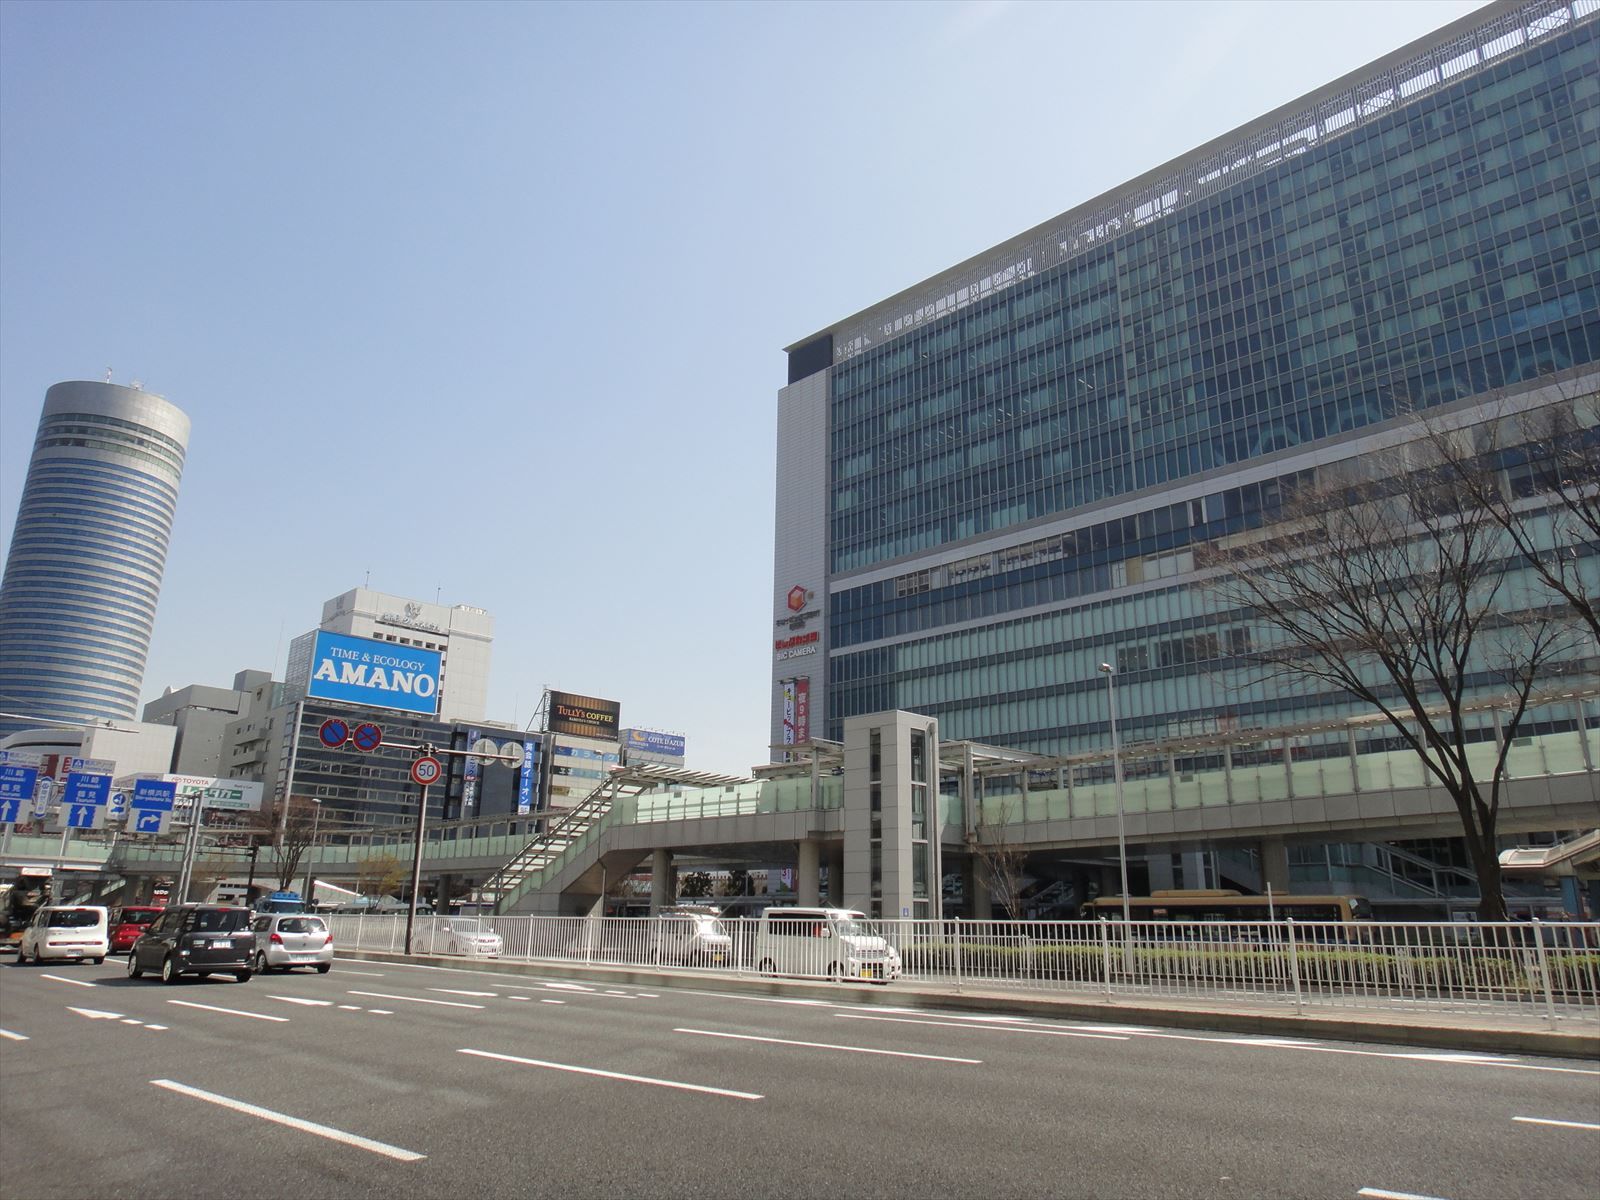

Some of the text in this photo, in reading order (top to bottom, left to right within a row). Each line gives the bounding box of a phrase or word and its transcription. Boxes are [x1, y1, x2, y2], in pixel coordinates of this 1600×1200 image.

[331, 647, 425, 672] TIME & ECOLOGY
[776, 646, 816, 661] BIC CAMERA
[314, 658, 436, 698] AMANO
[557, 705, 614, 723] TULLY'S COFFEE
[419, 765, 435, 777] 50
[521, 742, 534, 805] 英会話イーオン
